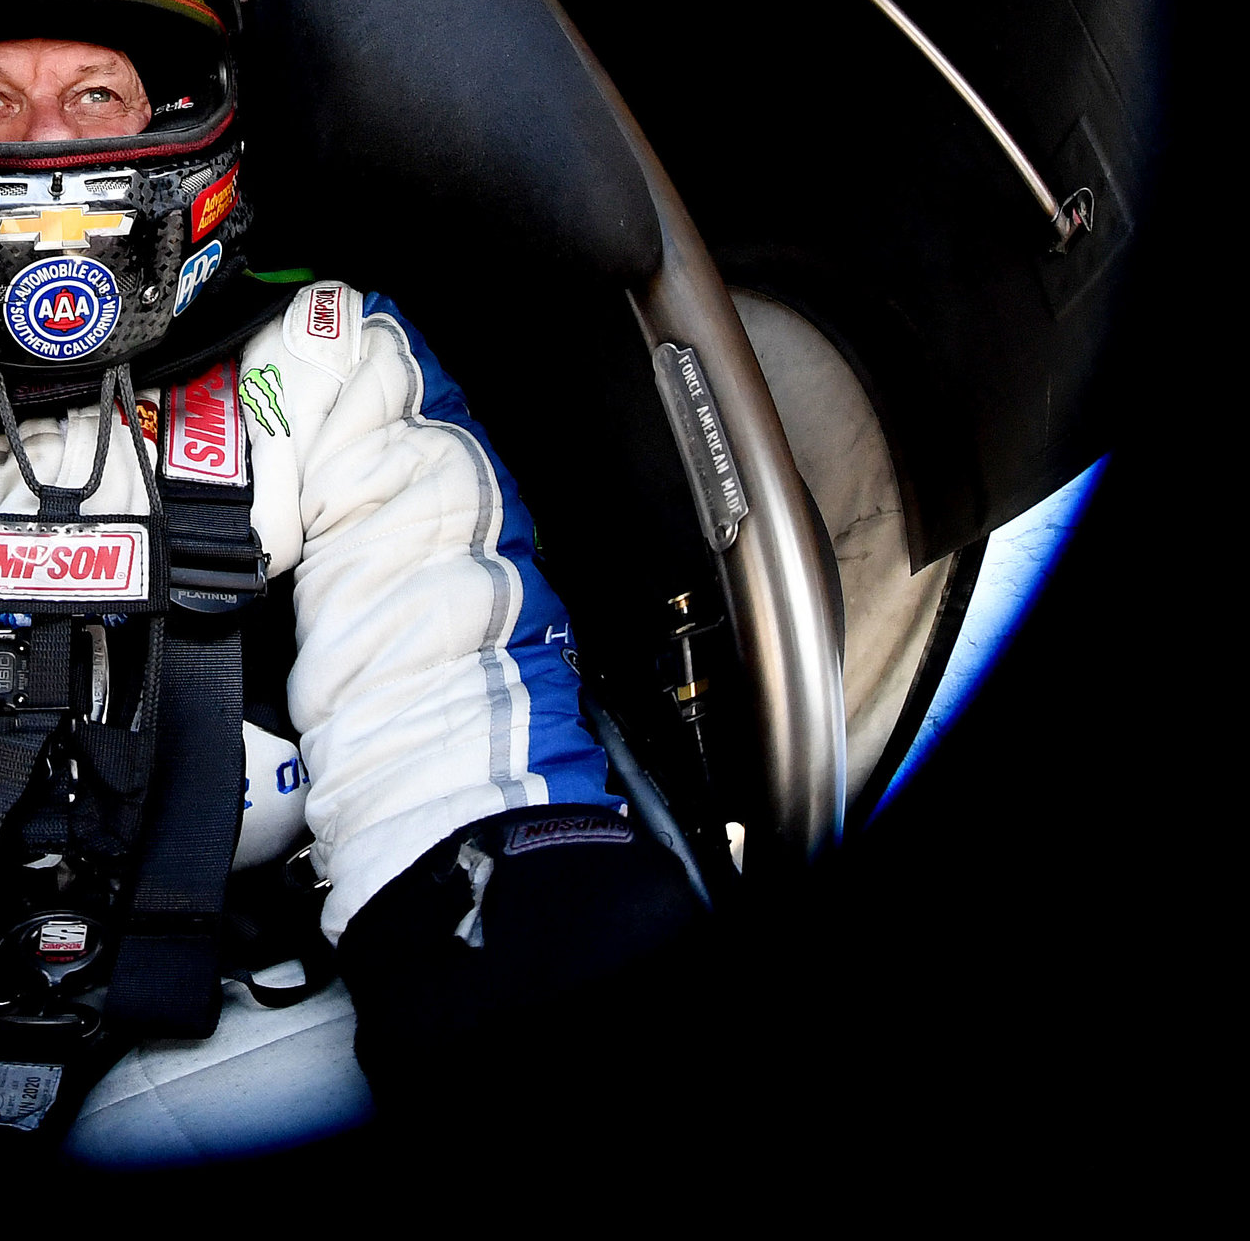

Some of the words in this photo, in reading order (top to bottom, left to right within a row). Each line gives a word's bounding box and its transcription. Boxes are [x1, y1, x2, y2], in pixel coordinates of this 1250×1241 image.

[15, 263, 89, 301] AUTOMOBILE
[177, 254, 218, 306] PPG
[10, 306, 60, 356] SOUTHERN
[63, 300, 116, 356] CALIFORNIA
[38, 295, 90, 322] AAA
[313, 289, 336, 333] SIMPSON
[678, 354, 705, 401] FORCE
[696, 405, 730, 475] AMERICAN
[721, 476, 743, 517] MADE
[178, 590, 238, 605] PLATINUM
[22, 1076, 41, 1100] 2020
